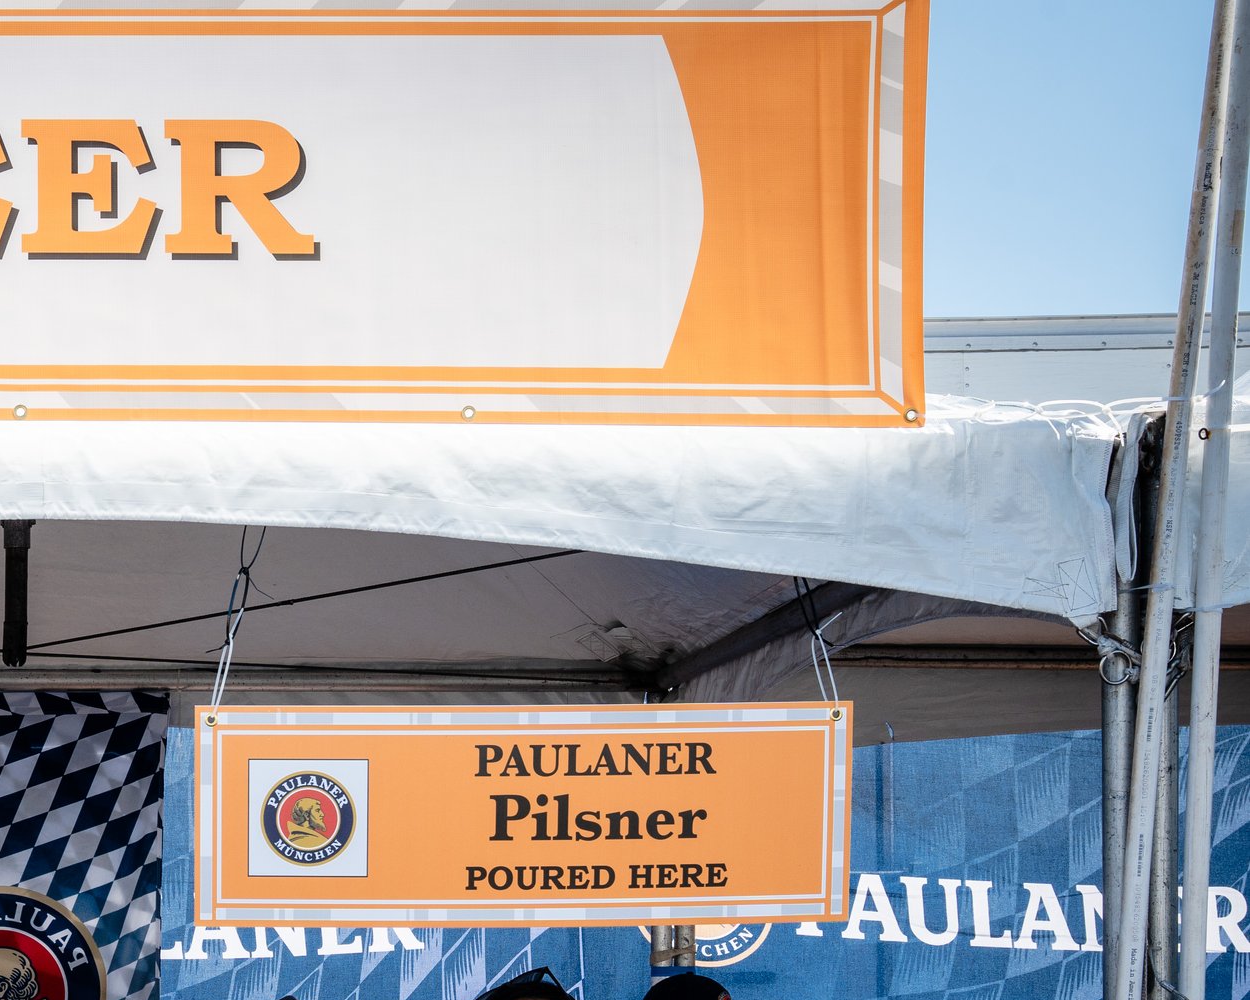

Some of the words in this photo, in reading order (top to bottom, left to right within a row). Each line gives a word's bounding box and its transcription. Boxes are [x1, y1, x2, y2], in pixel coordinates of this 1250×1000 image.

[1198, 196, 1208, 224] America
[1192, 272, 1199, 280] JM
[1189, 284, 1198, 305] EAGLE
[1182, 352, 1190, 365] SCH
[1181, 368, 1188, 377] 40
[474, 742, 716, 777] PAULANER
[268, 775, 349, 808] PAULANER
[489, 793, 707, 842] Pilsner
[274, 839, 342, 861] MÜNCHEN
[465, 865, 615, 891] POURED
[628, 863, 728, 889] HERE
[1129, 968, 1136, 977] in
